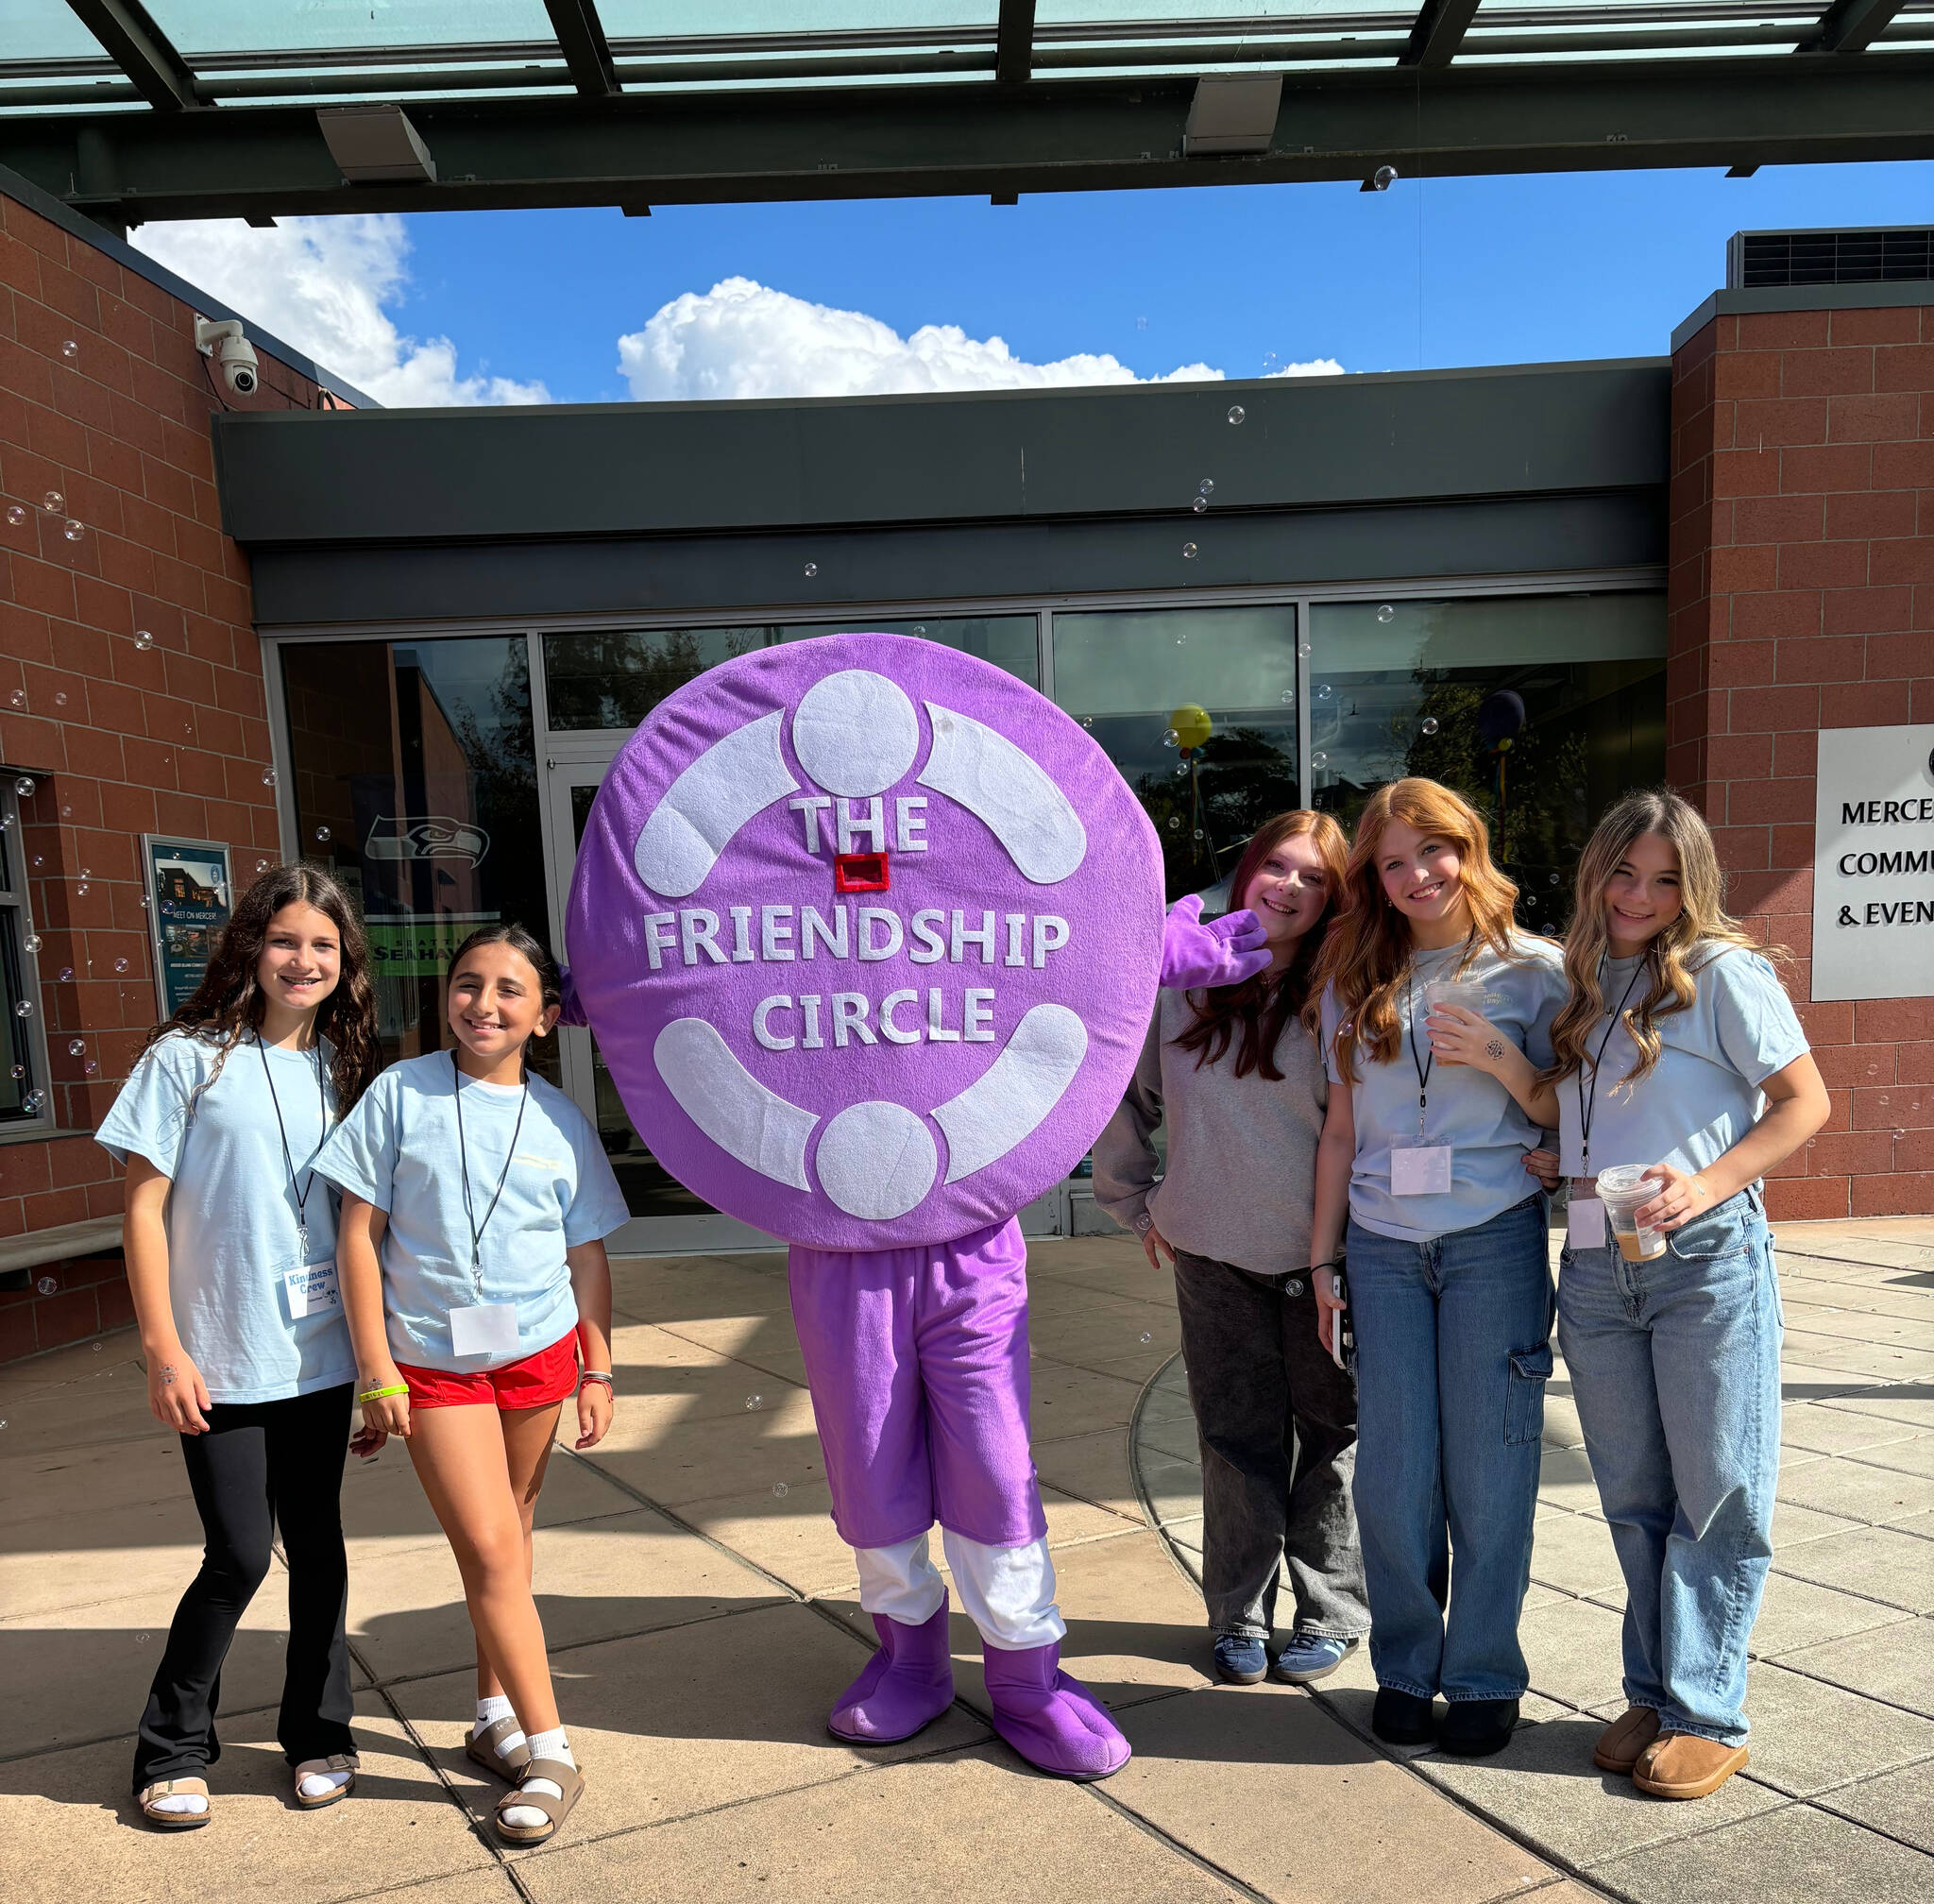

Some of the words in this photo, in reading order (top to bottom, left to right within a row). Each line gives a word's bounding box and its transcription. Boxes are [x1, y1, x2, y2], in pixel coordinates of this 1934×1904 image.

[1841, 798, 1933, 824] MERCE
[789, 796, 928, 854] THE
[1839, 850, 1934, 875] COMM
[1839, 905, 1861, 926] &
[1866, 900, 1934, 925] EVEN
[643, 904, 1070, 970] FRIENDSHIP
[753, 987, 995, 1050] CIRCLE
[299, 1281, 326, 1294] Crew
